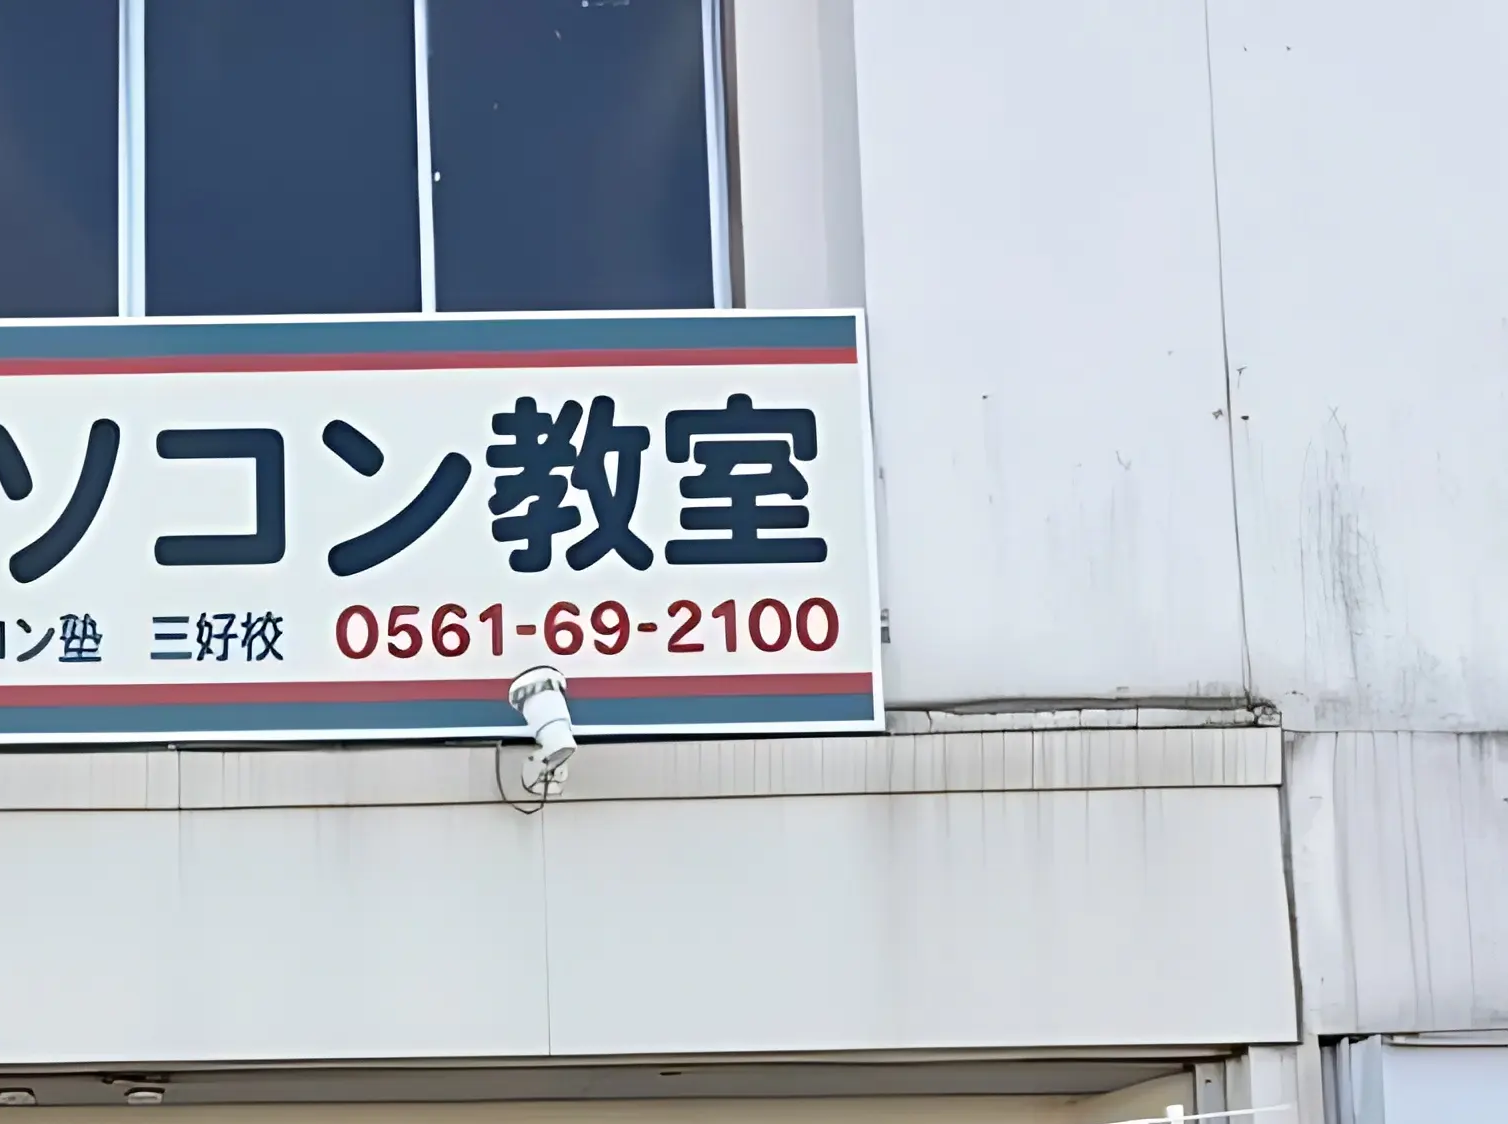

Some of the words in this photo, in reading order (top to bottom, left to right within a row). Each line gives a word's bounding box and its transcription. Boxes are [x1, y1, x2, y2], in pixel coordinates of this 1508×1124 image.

[150, 610, 284, 662] 三好校
[335, 596, 841, 660] 0561-69-2100
